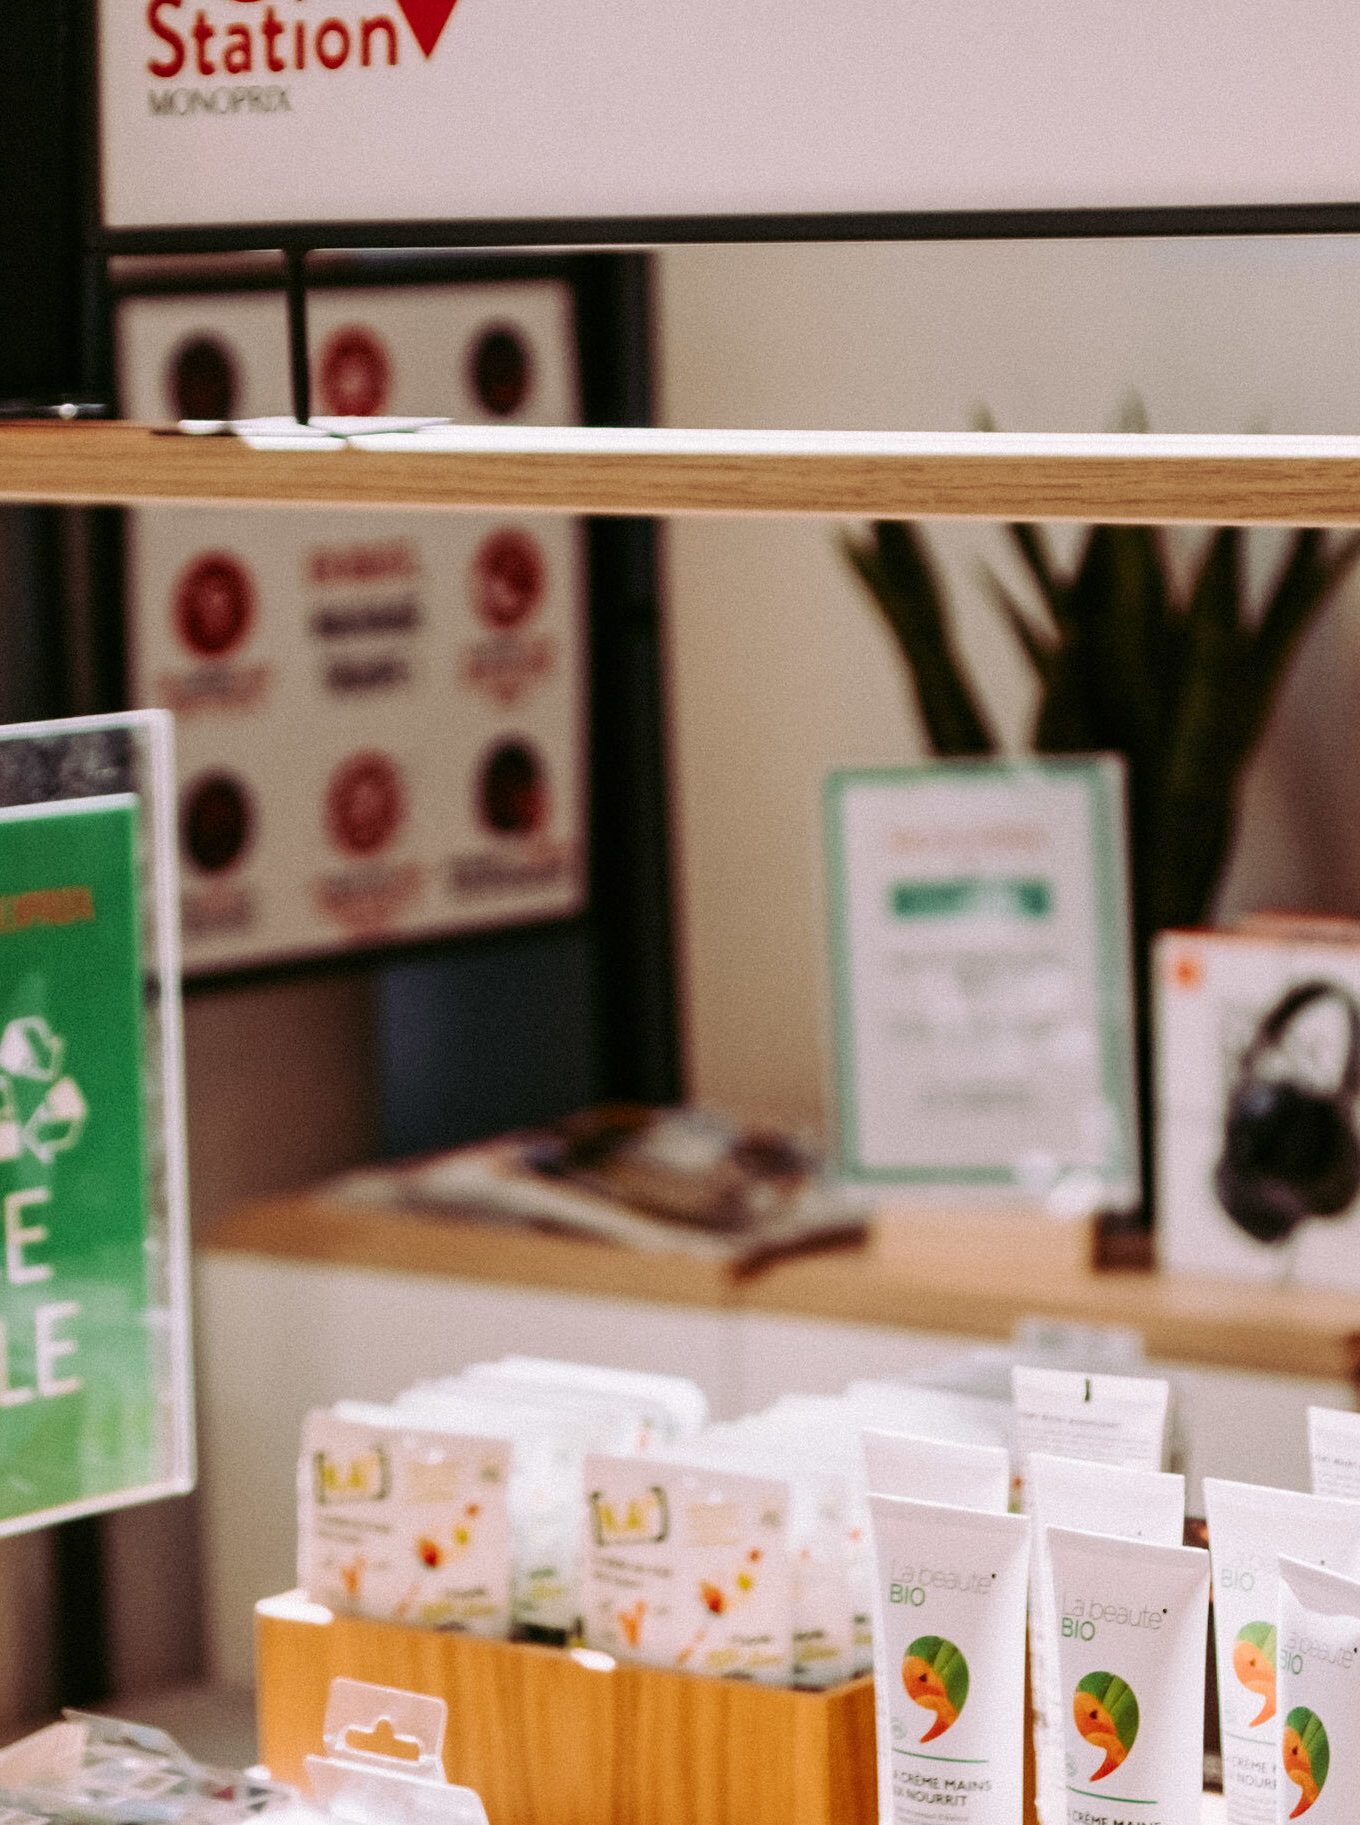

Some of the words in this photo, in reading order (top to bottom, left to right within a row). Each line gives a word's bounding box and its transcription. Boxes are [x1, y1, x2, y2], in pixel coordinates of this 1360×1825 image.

[146, 84, 293, 116] MONOPRIX
[890, 1582, 925, 1606] BIO
[1061, 1617, 1095, 1641] BIO
[944, 1778, 992, 1792] MAINS
[906, 1790, 967, 1806] NOURRIT
